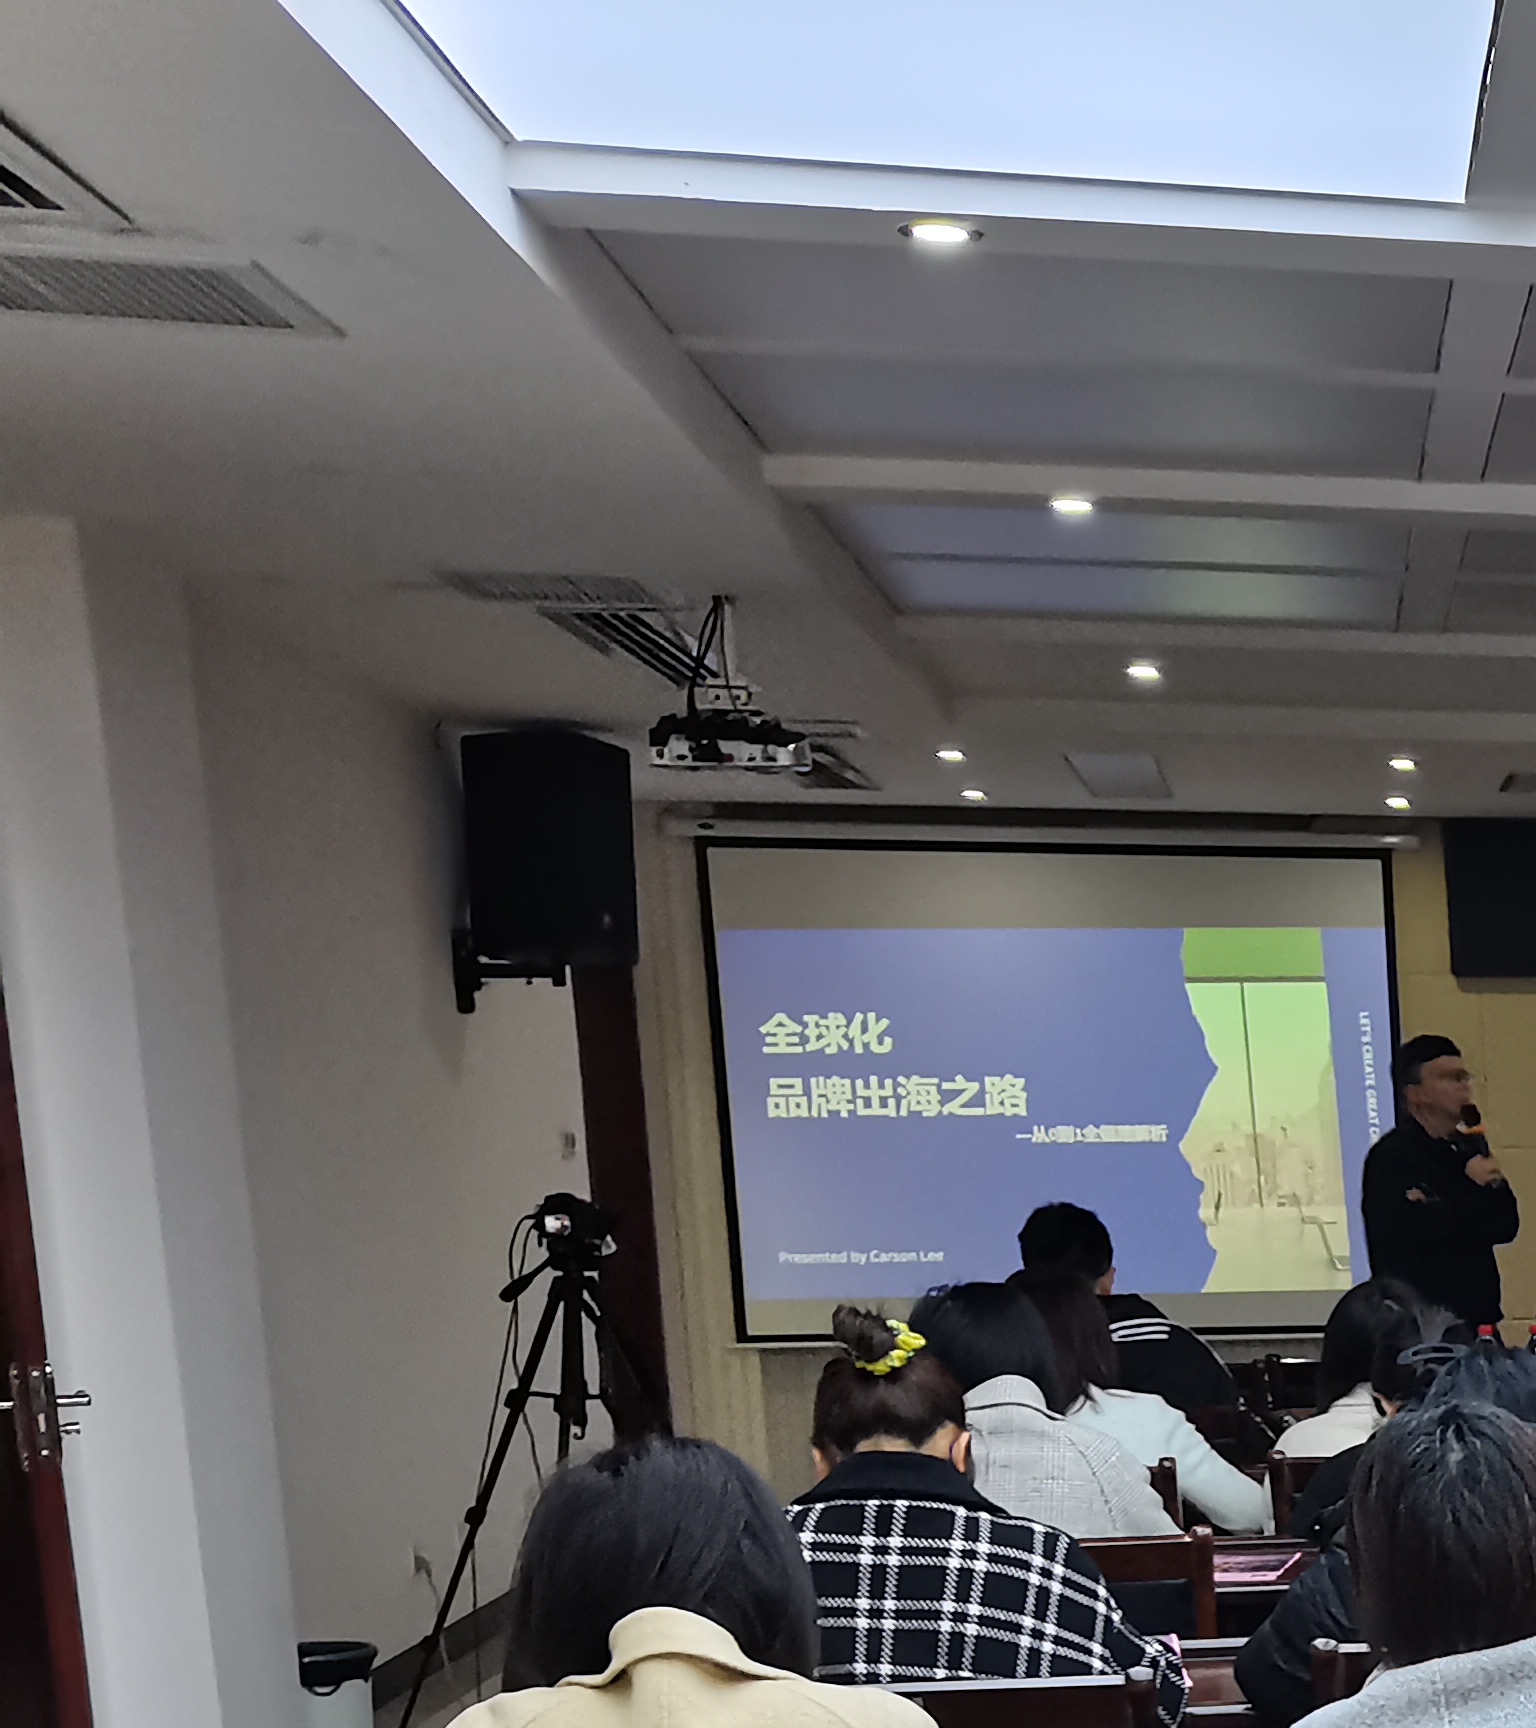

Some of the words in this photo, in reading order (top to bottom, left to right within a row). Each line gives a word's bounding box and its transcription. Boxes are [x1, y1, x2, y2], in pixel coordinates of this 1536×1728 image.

[758, 1012, 893, 1054] 全球化
[767, 1074, 1028, 1118] 品牌出海之路
[779, 1251, 847, 1264] Presented
[850, 1251, 867, 1265] by
